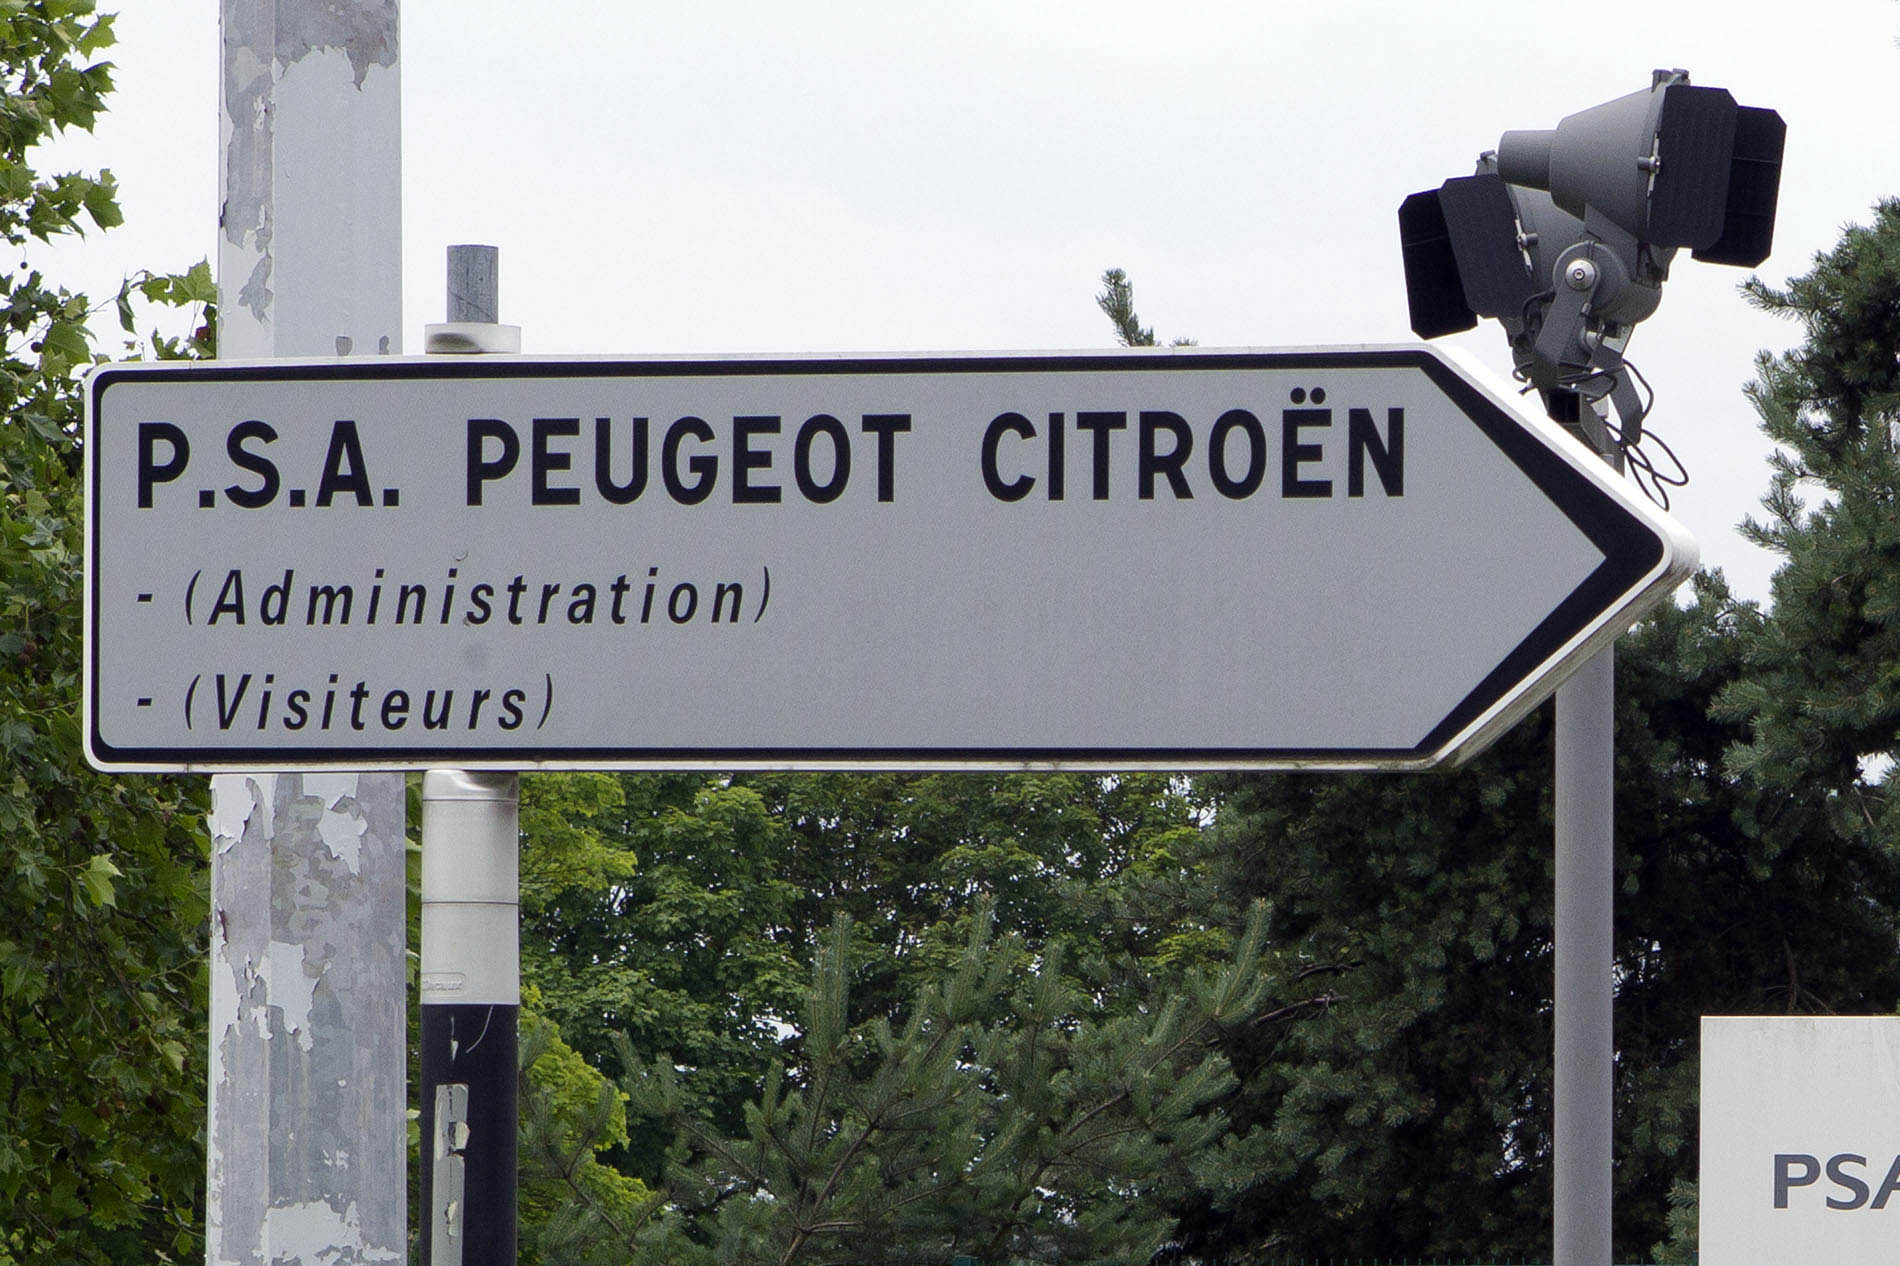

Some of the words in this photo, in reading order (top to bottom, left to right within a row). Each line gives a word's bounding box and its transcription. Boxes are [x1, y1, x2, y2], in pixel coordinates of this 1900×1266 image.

[137, 419, 400, 510] P.S.A.
[466, 413, 913, 507] PEUGEOT
[981, 386, 1405, 503] CITROËN
[184, 565, 771, 626] (Administration)
[183, 673, 555, 731] (Visiteurs)
